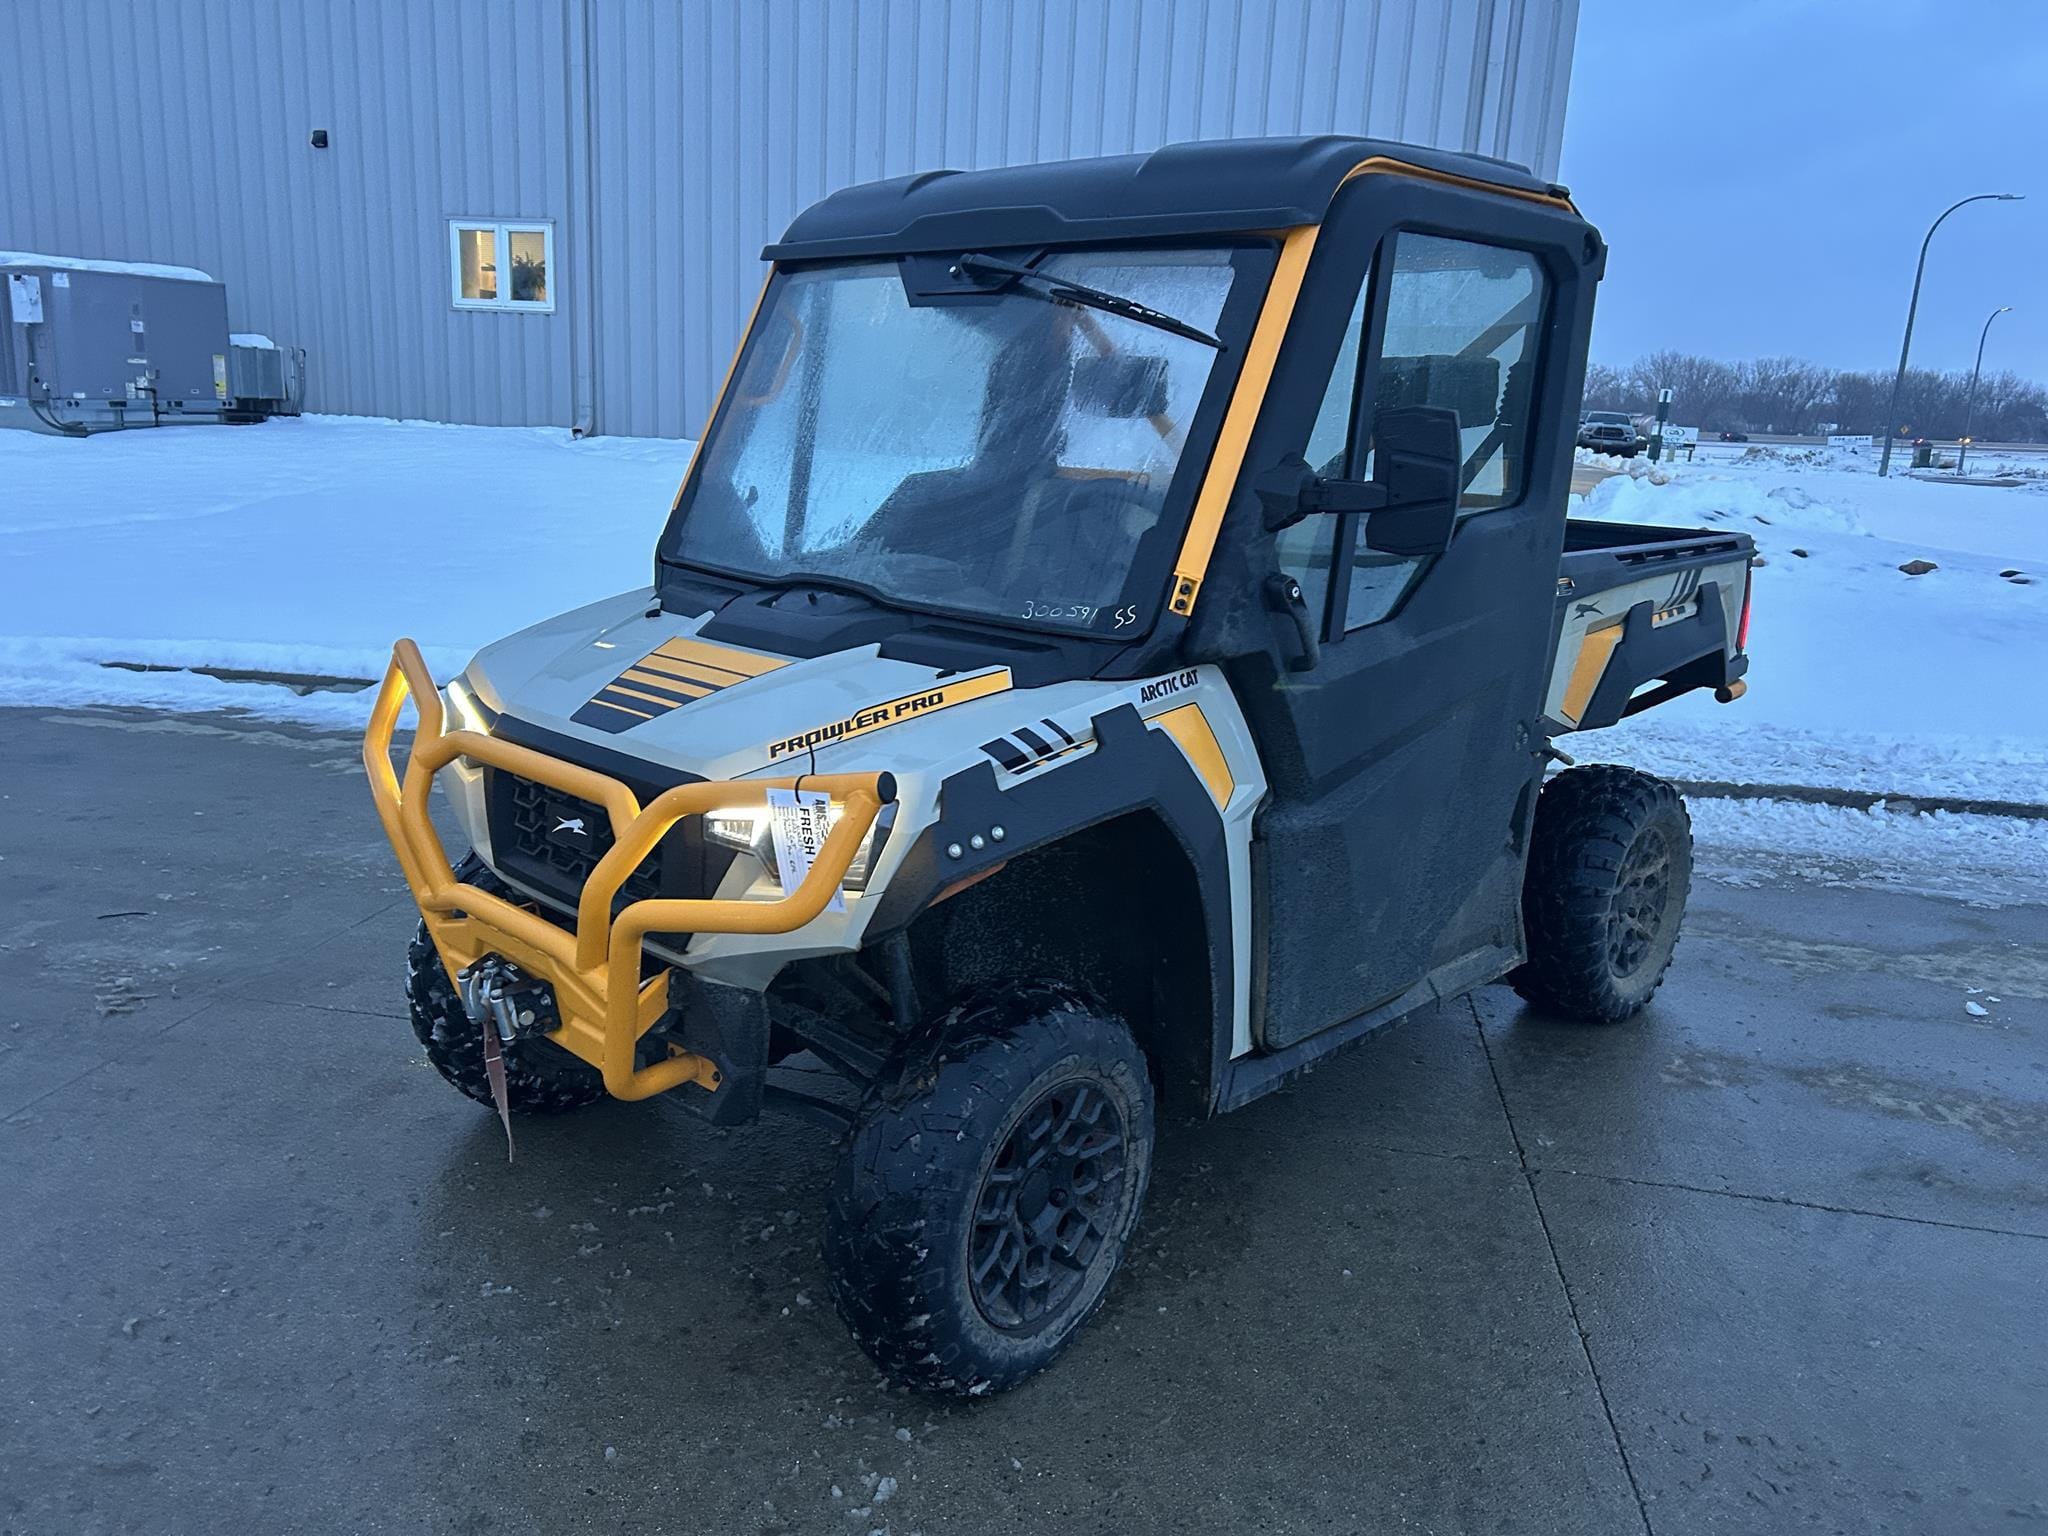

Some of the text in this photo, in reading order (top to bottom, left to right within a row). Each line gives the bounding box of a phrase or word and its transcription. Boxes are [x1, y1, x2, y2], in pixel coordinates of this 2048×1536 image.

[1021, 600, 1099, 625] 300591
[1140, 669, 1200, 704] ARCTIC CAT
[769, 692, 944, 759] PROWLER PRO
[799, 807, 816, 855] FRESH
